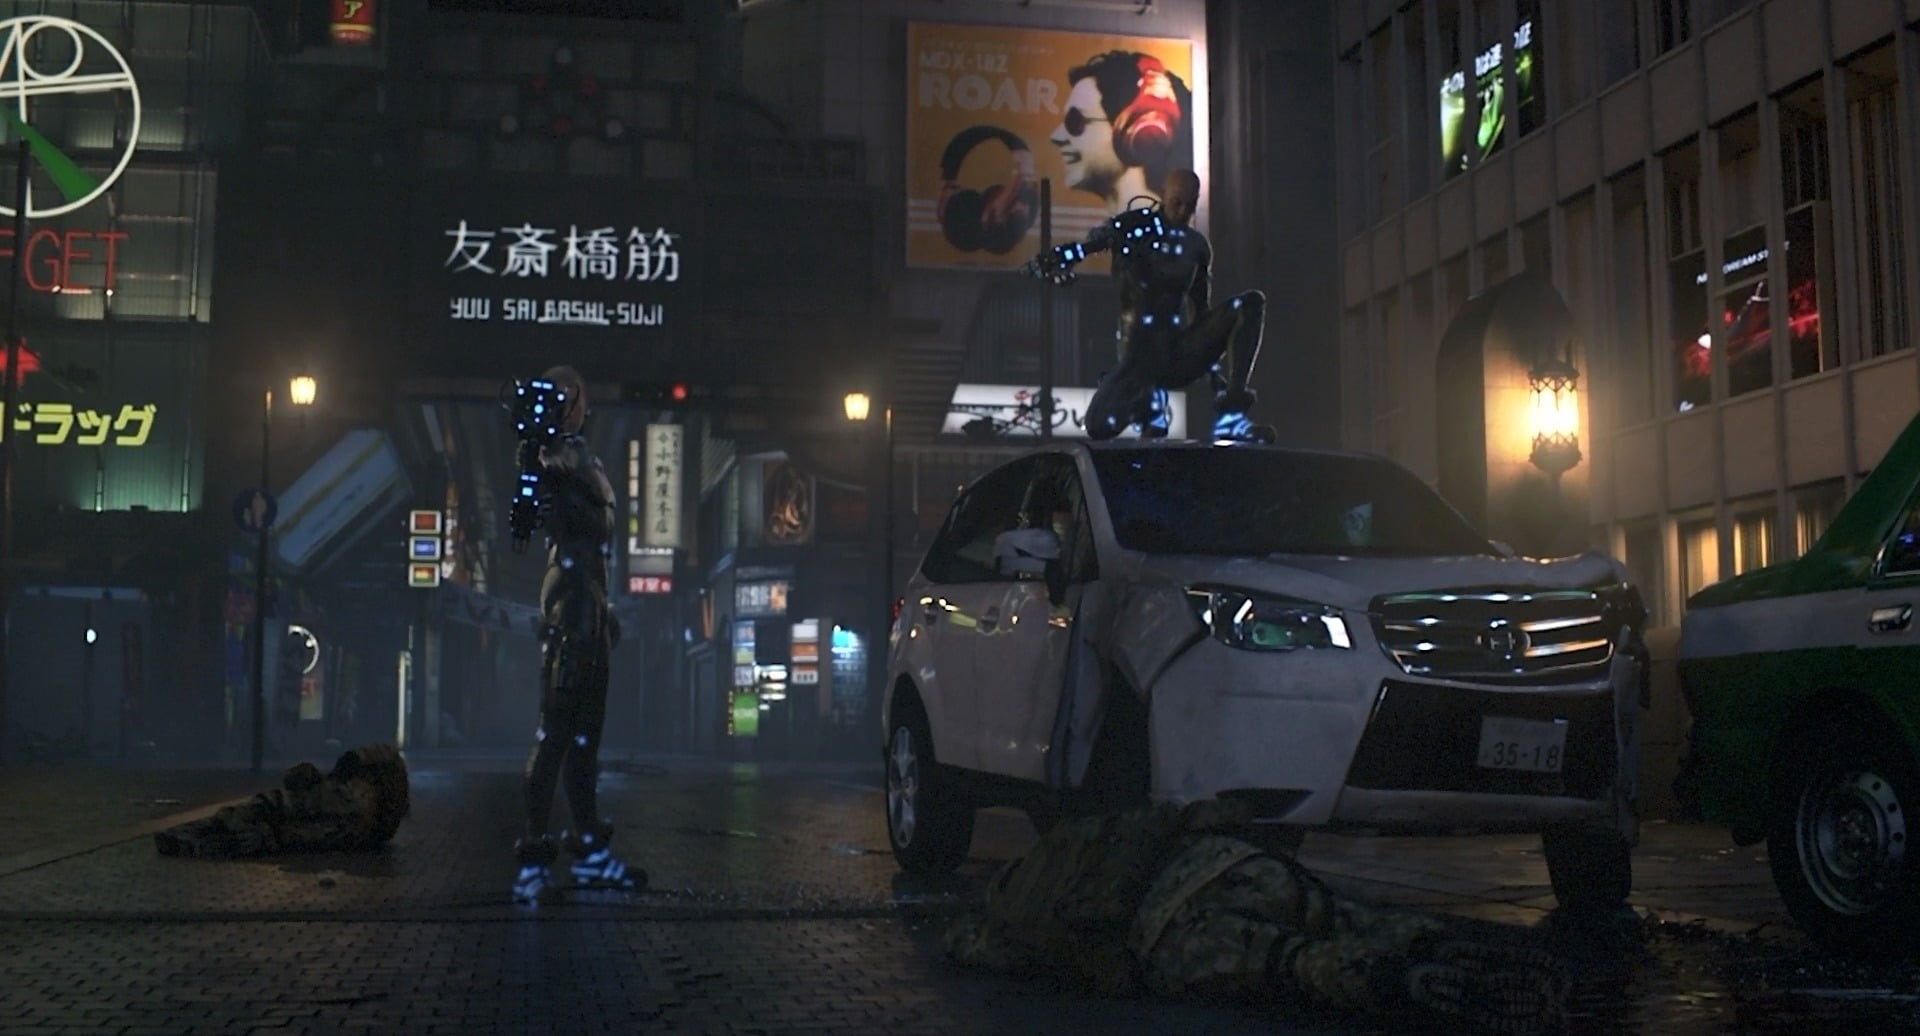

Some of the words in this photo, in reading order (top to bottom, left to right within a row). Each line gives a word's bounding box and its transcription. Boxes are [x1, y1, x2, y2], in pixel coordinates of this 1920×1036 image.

[918, 73, 1061, 114] ROAR
[451, 297, 490, 320] YUU
[0, 402, 157, 446] ドラッグ
[1493, 741, 1560, 769] 35-18
